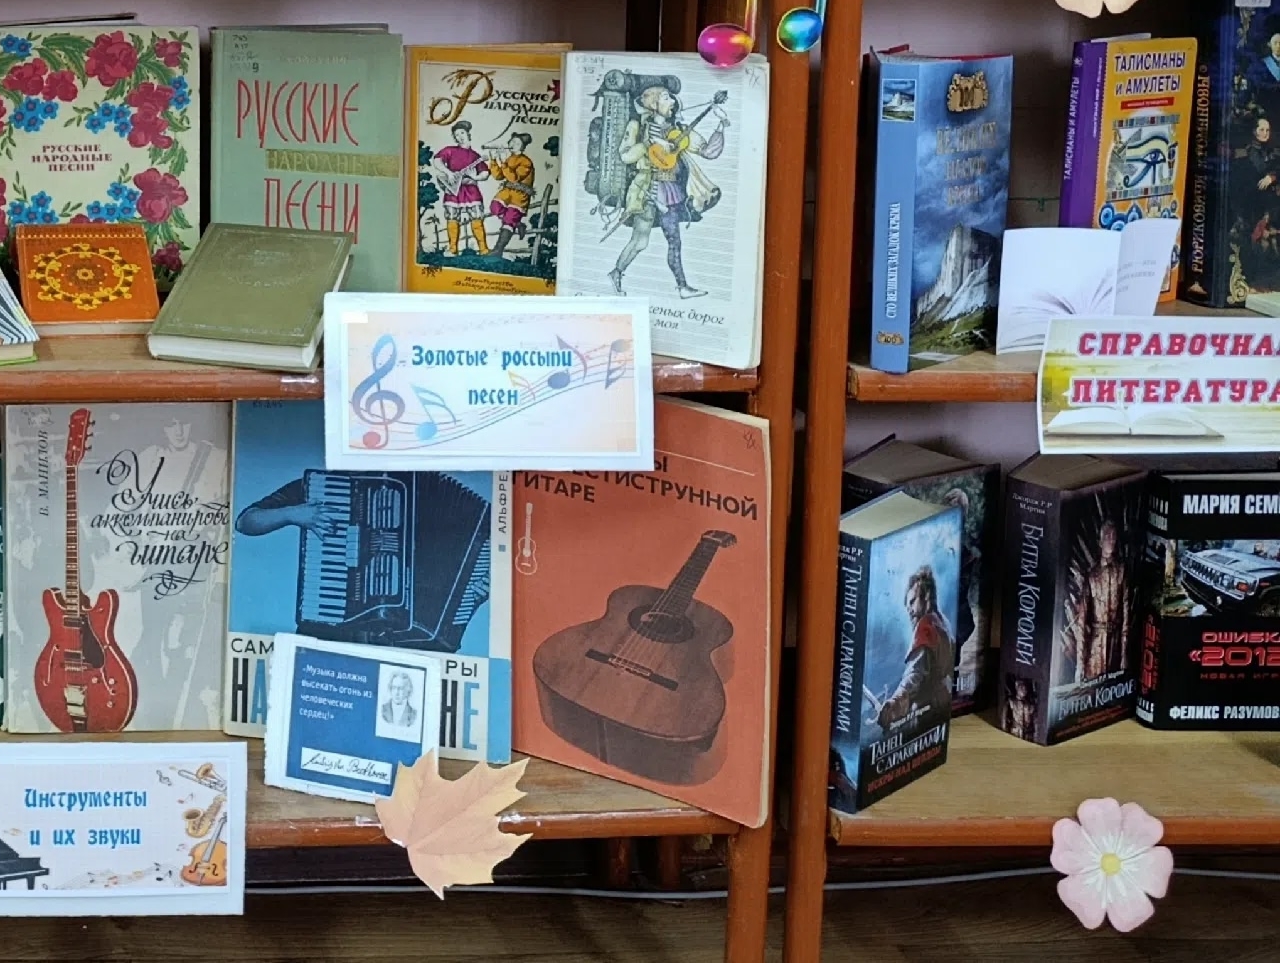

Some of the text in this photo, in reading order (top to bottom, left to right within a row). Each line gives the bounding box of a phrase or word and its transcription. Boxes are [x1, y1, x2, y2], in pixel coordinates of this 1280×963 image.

[1114, 52, 1186, 72] ТАЛИСМАНЫ
[1125, 75, 1181, 95] АМУЛЕТЫ
[1069, 77, 1080, 118] АМУЛЕТЫ
[237, 79, 360, 149] РУССКИЕ
[31, 153, 113, 164] НАРОДНЫЕ
[42, 144, 102, 154] РУССКИЕ
[1063, 127, 1076, 181] ТАЛИСМАНЫ
[48, 163, 96, 172] ПЕСНИ
[264, 178, 360, 245] ПЕСНИ
[1192, 175, 1207, 274] РЮРИКОВИЧИ
[887, 202, 901, 319] СТО ВЕЛИКИХ ЗАГАДОК КРЫМА
[654, 319, 679, 330] моя
[687, 309, 725, 326] дорог
[1078, 333, 1280, 357] СПРАВОЧНА
[411, 345, 572, 371] Золотые россыпи
[468, 388, 519, 406] песен
[38, 430, 48, 500] МАНИЛОВ
[96, 449, 197, 512] Учись
[1183, 494, 1240, 515] МАРИЯ
[115, 541, 228, 586] гитаре
[842, 565, 863, 613] ТАНЕЦ
[1015, 522, 1044, 666] БИТВА КОРОЛЕЙ
[301, 679, 338, 693] высекать
[339, 685, 362, 697] огонь
[336, 670, 367, 683] должна
[836, 633, 855, 733] ДРАКОНАМИ
[300, 694, 354, 710] человеческих
[1170, 705, 1220, 720] ФЕЛИКС
[870, 733, 902, 766] ТАНЕЦ
[24, 788, 147, 811] Инструменты
[30, 829, 141, 848] и их звуки
